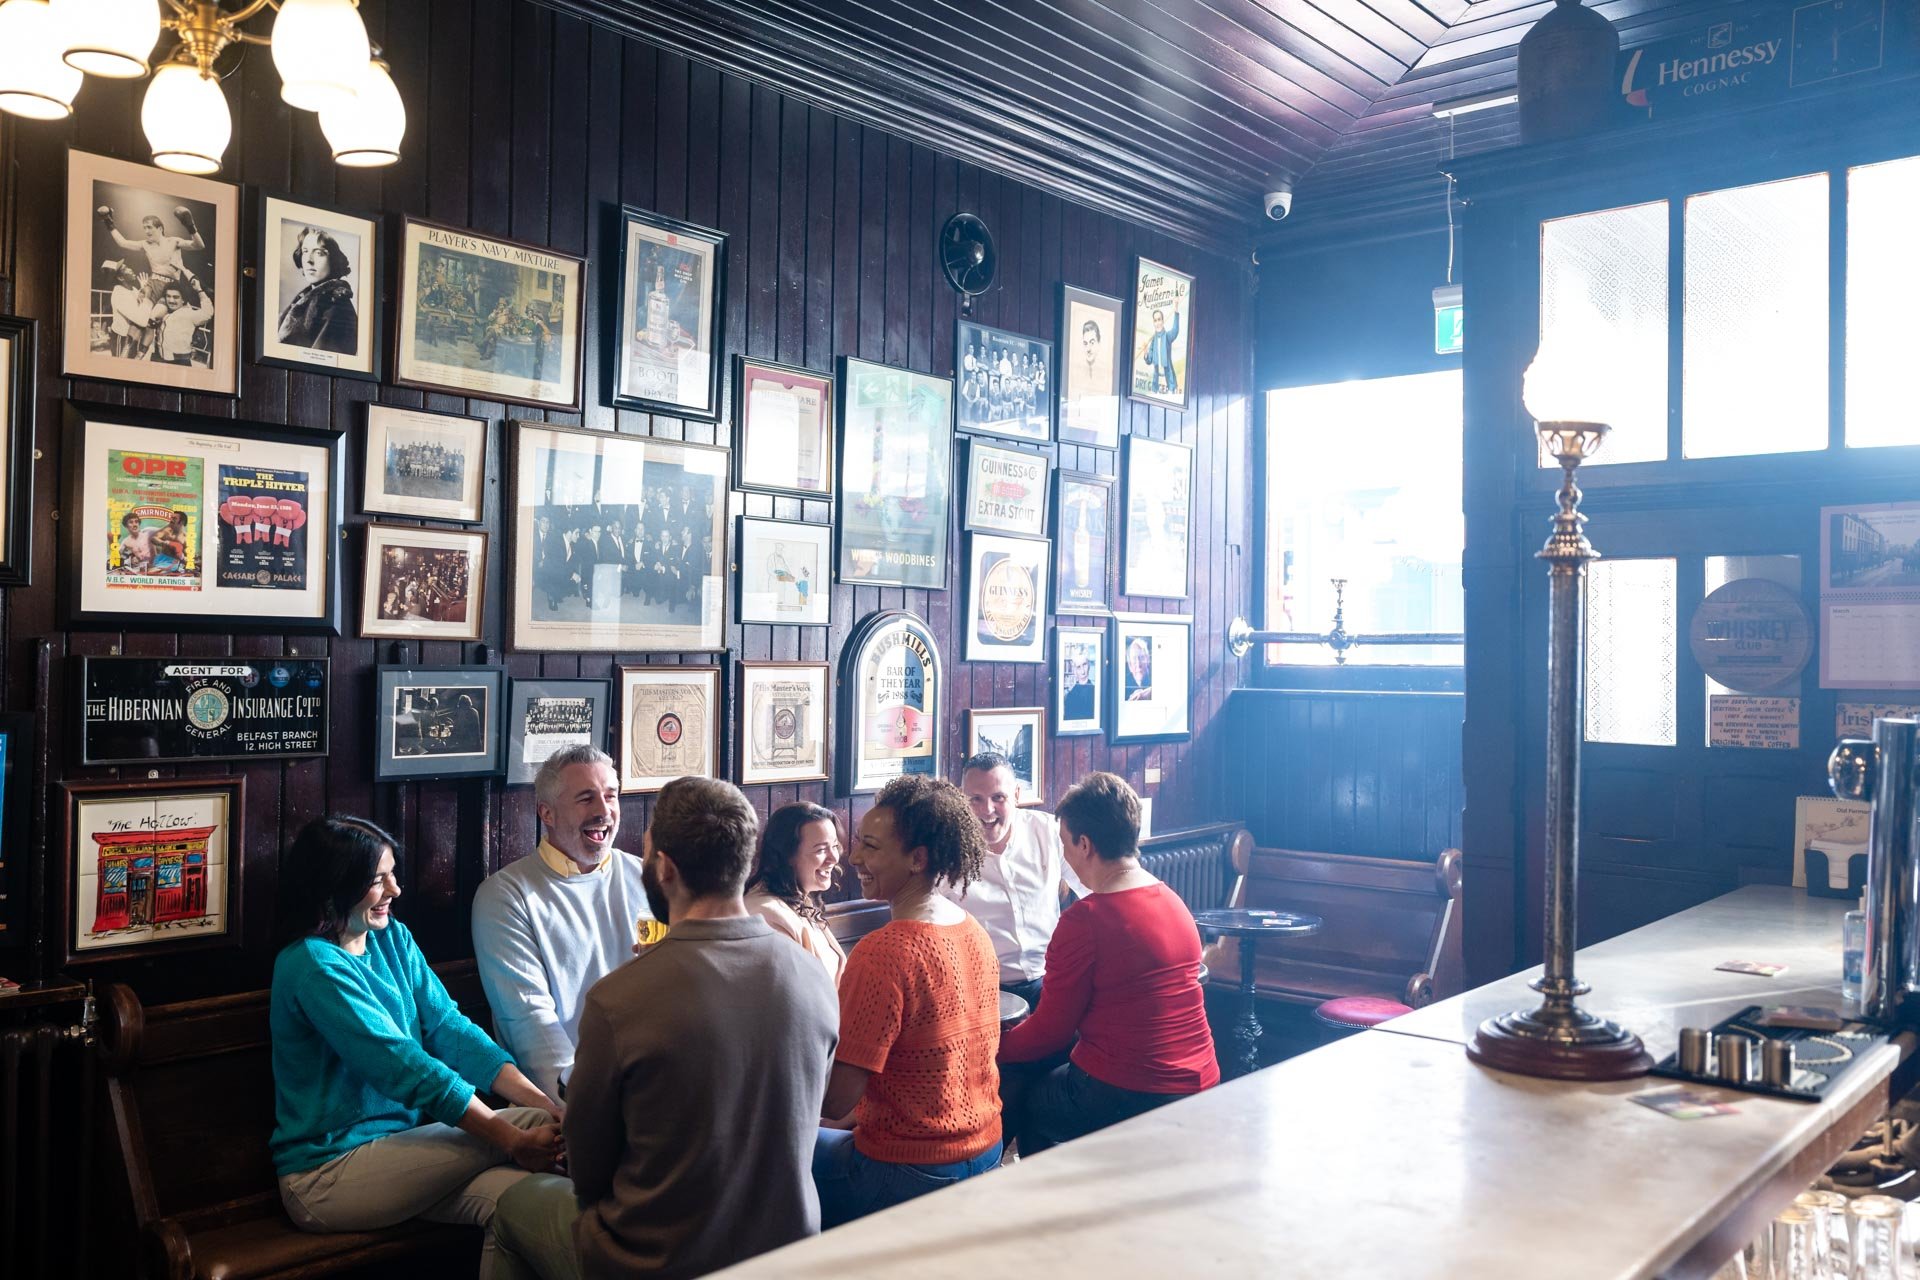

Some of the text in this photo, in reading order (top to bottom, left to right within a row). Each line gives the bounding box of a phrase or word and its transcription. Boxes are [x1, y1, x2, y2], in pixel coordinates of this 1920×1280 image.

[1658, 38, 1782, 86] Hennessy
[1683, 71, 1751, 97] COGNAC
[428, 230, 560, 271] PLAYER'S NAVY MIXTURE
[122, 456, 187, 477] QPR
[981, 458, 1023, 478] GUINNESS
[223, 476, 306, 492] TRIPLE HITTER
[256, 472, 274, 481] THE
[978, 499, 1035, 522] EXTRA STOUT
[885, 551, 936, 567] WOODBINES
[222, 571, 302, 582] CAESARS PALACE
[1706, 620, 1791, 643] WHISKEY
[871, 633, 931, 667] BUSHMILLS
[1735, 642, 1762, 650] CLUB
[173, 667, 244, 675] AGENT FOR
[886, 666, 916, 677] BAR OF
[185, 678, 231, 694] FIRE AND
[880, 678, 921, 688] THE YEAR
[87, 704, 106, 716] THE
[108, 697, 183, 721] HIBERNIAN
[233, 695, 293, 719] INSURANCE
[185, 724, 233, 739] GENERAL
[237, 730, 318, 742] BELFAST BRANCH
[258, 742, 281, 750] HIGH
[285, 740, 317, 749] STREET
